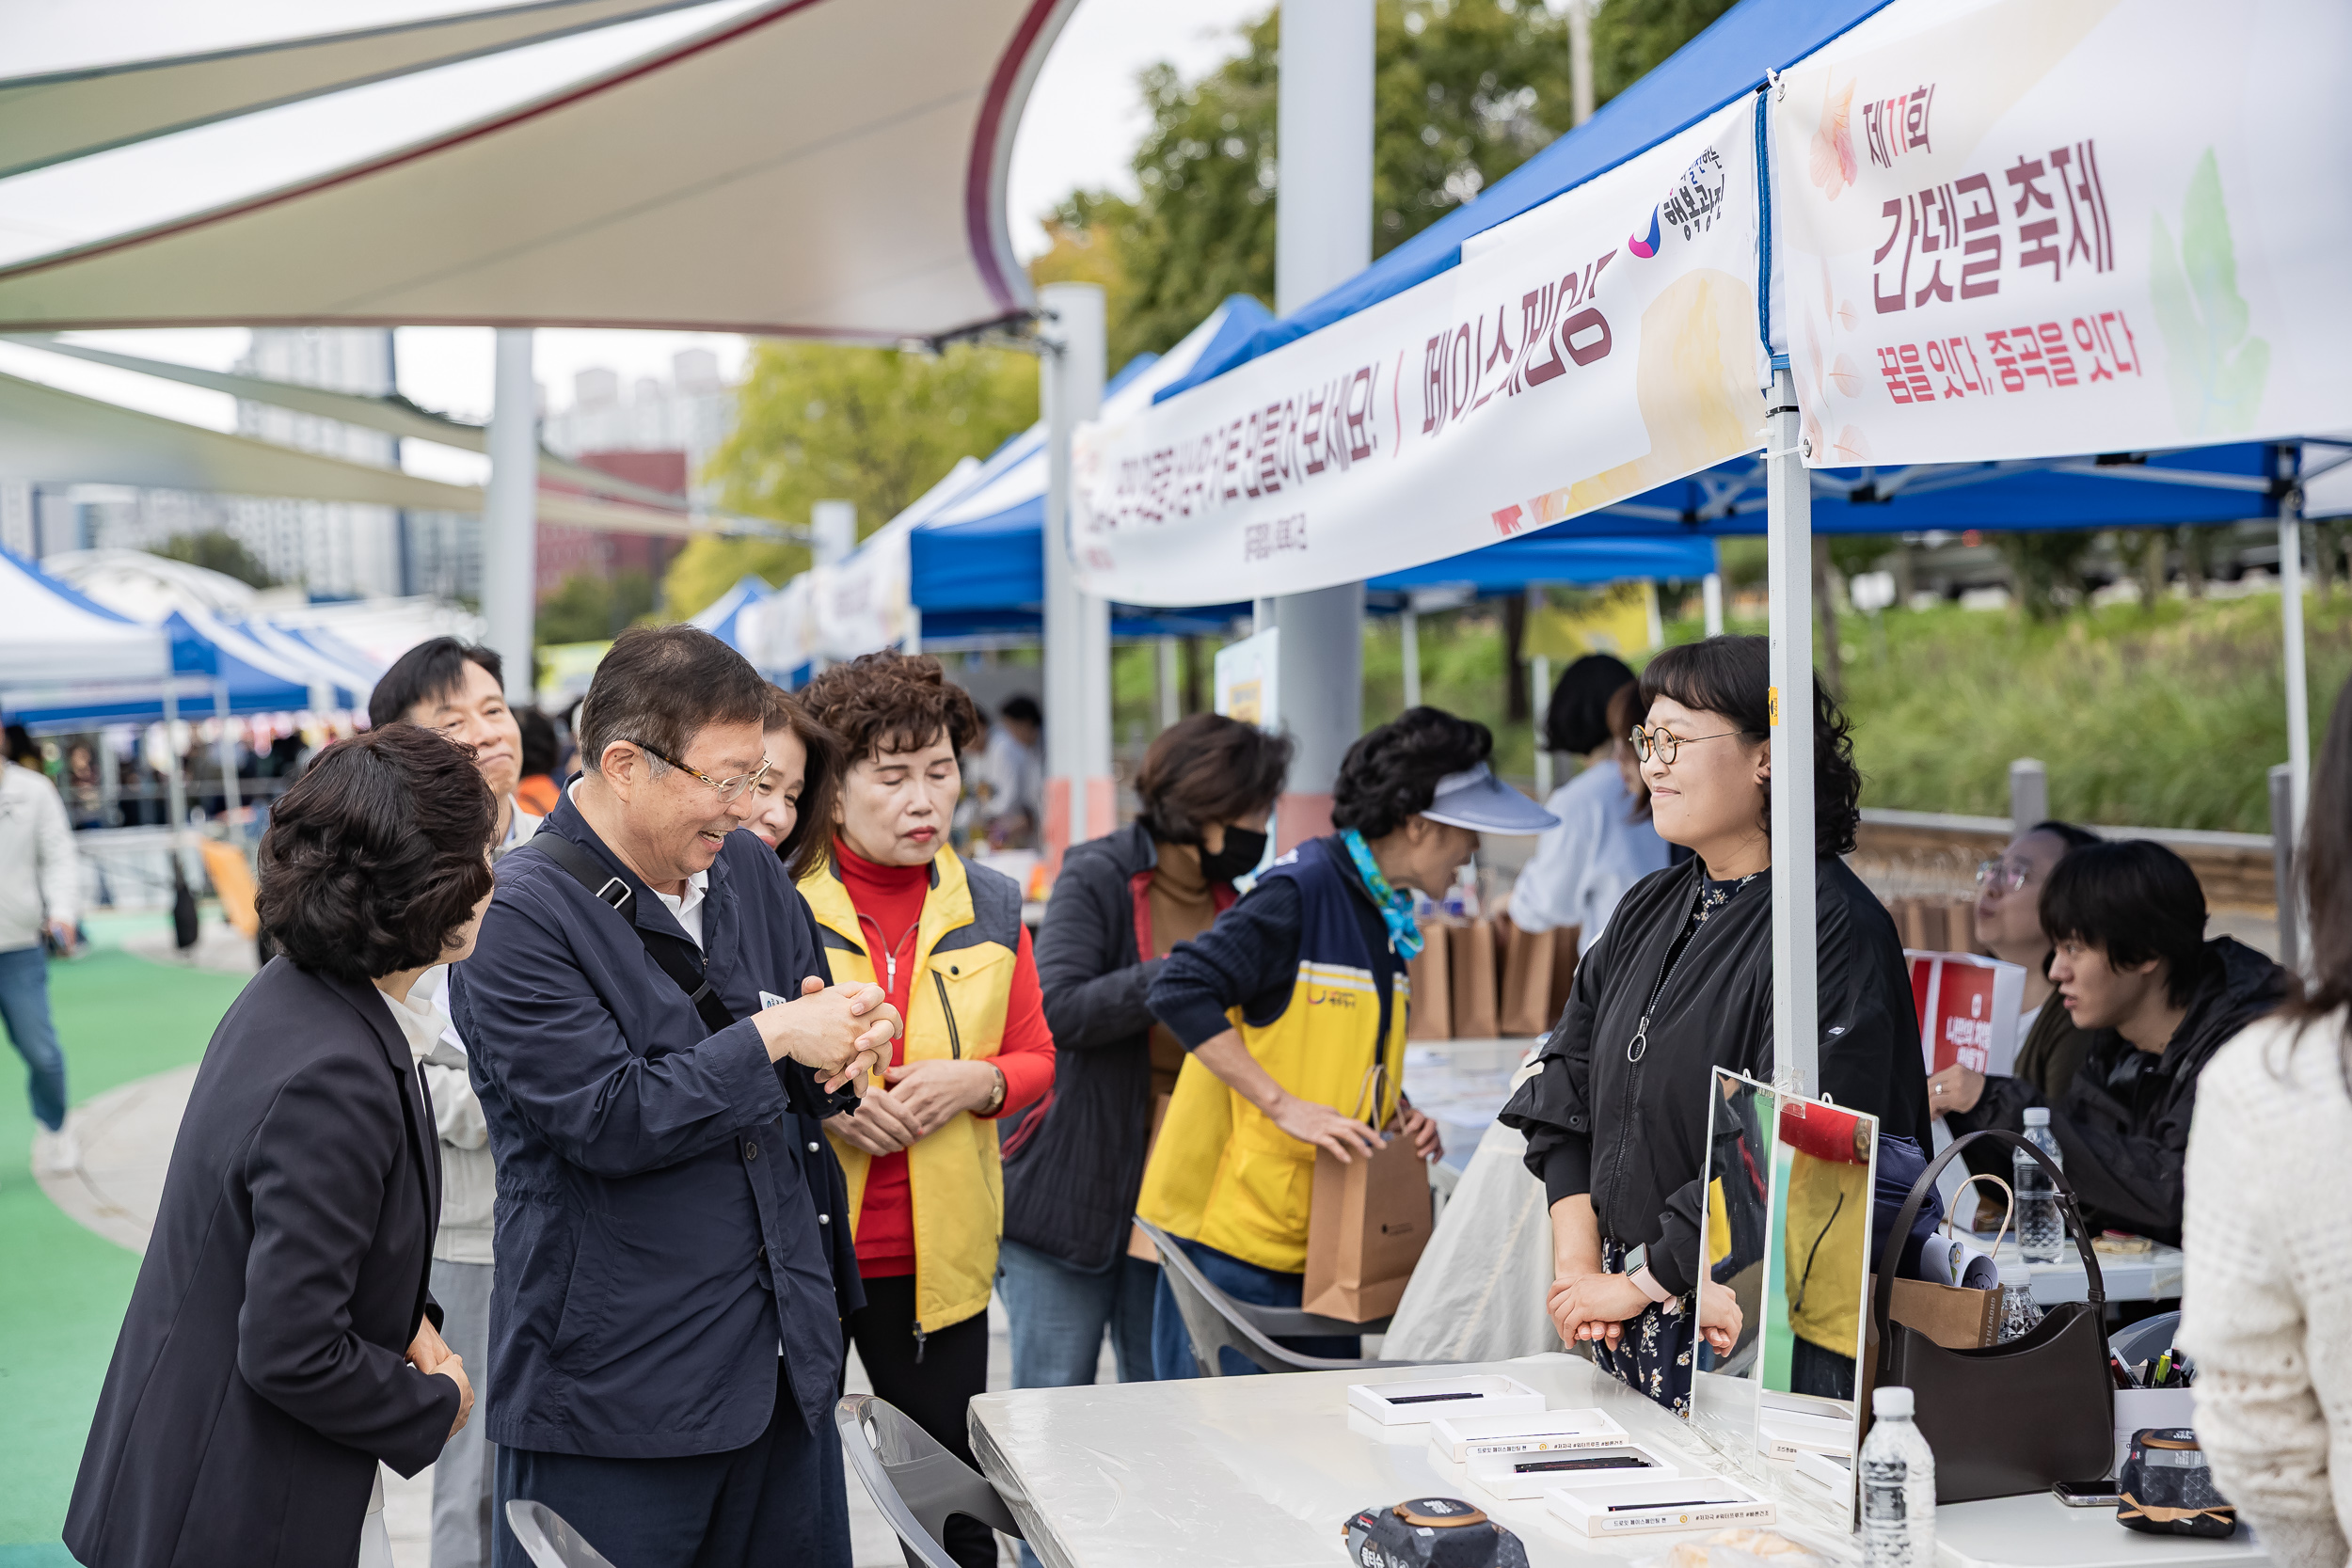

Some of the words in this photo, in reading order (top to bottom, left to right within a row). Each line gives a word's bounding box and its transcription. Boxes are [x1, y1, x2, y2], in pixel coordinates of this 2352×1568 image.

[1863, 83, 1935, 169] 제11회
[1663, 173, 1725, 242] 행복광진
[1872, 171, 2001, 315] 간뎃골
[2005, 137, 2115, 282] 축제
[1422, 248, 1618, 438] 페이스페인팅
[1876, 342, 1936, 404] 꿈을
[1926, 335, 1994, 399] 잇다,
[1984, 321, 2079, 393] 중곡을
[2072, 309, 2142, 383] 잇다
[1629, 1517, 1661, 1526] 페이스페인팅
[1745, 1510, 1770, 1518] #빠른건조
